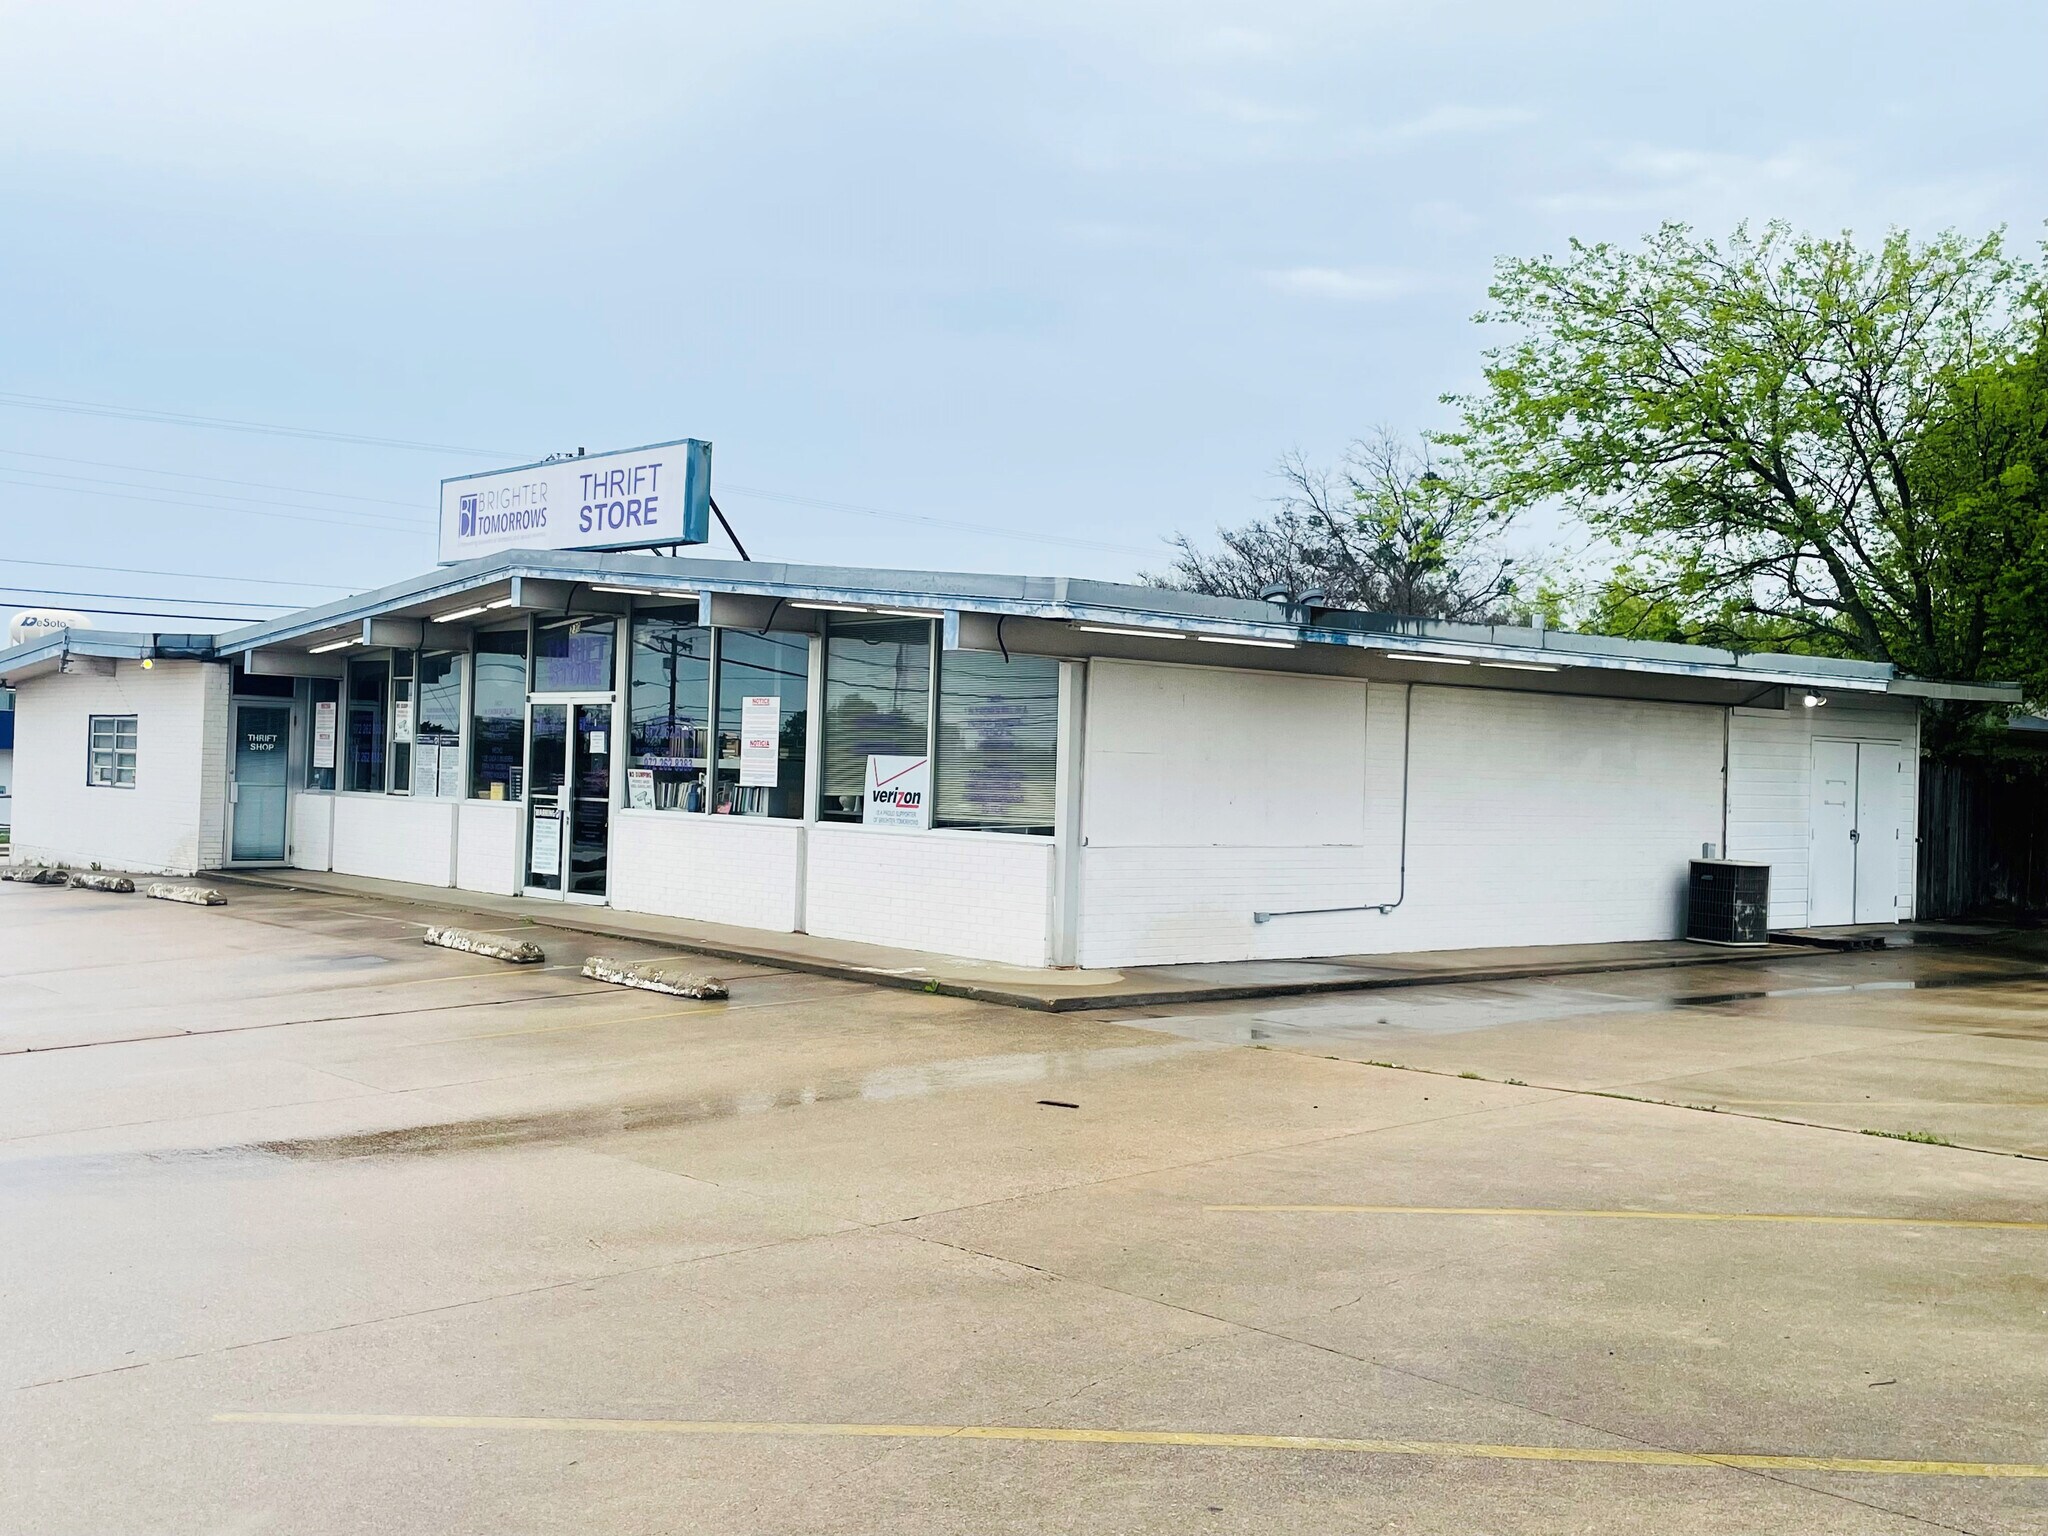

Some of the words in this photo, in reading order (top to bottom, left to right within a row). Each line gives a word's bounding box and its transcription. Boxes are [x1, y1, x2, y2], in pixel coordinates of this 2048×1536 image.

[579, 463, 662, 501] THRIFT
[478, 482, 548, 512] BRIGHTER
[478, 506, 548, 536] TOMORROWS
[578, 496, 659, 533] STORE
[20, 616, 67, 628] DeSoto
[247, 733, 278, 742] THRIFT
[250, 743, 274, 751] SHOP
[644, 758, 657, 770] 972
[659, 758, 672, 771] 262
[872, 786, 921, 808] verizon
